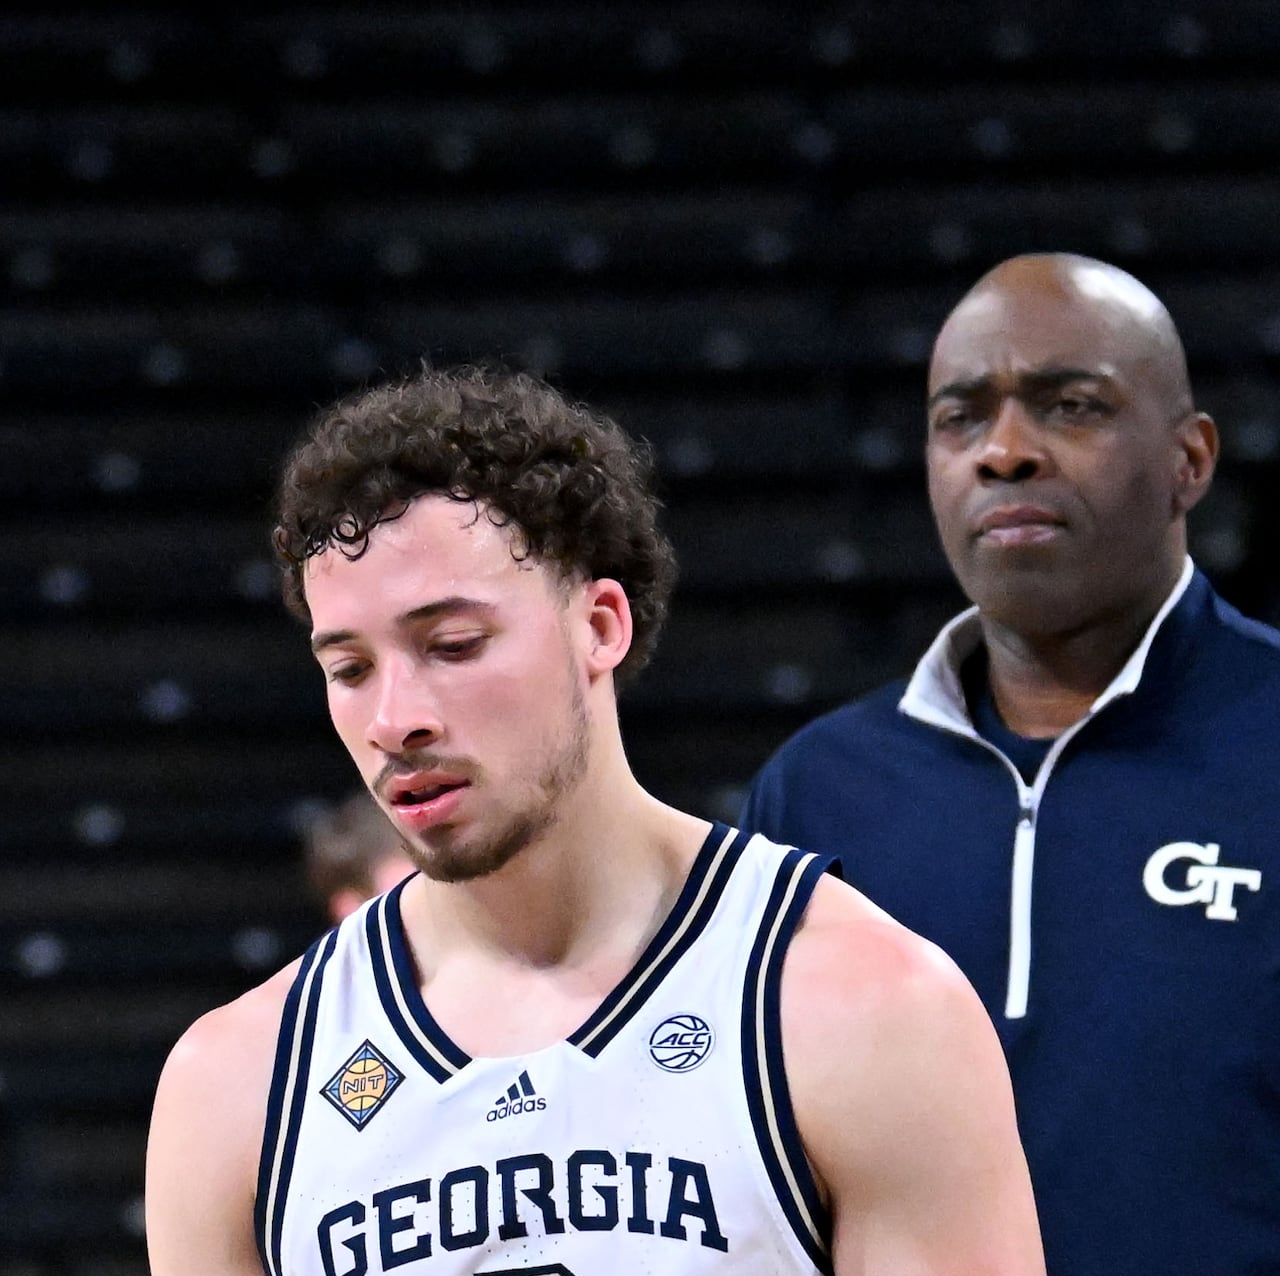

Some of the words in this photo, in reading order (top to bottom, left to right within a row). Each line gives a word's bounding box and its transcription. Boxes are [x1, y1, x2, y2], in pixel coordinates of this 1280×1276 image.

[1142, 841, 1262, 921] GT
[656, 1033, 710, 1046] ACC
[342, 1074, 384, 1095] NIT
[486, 1097, 547, 1122] adidas
